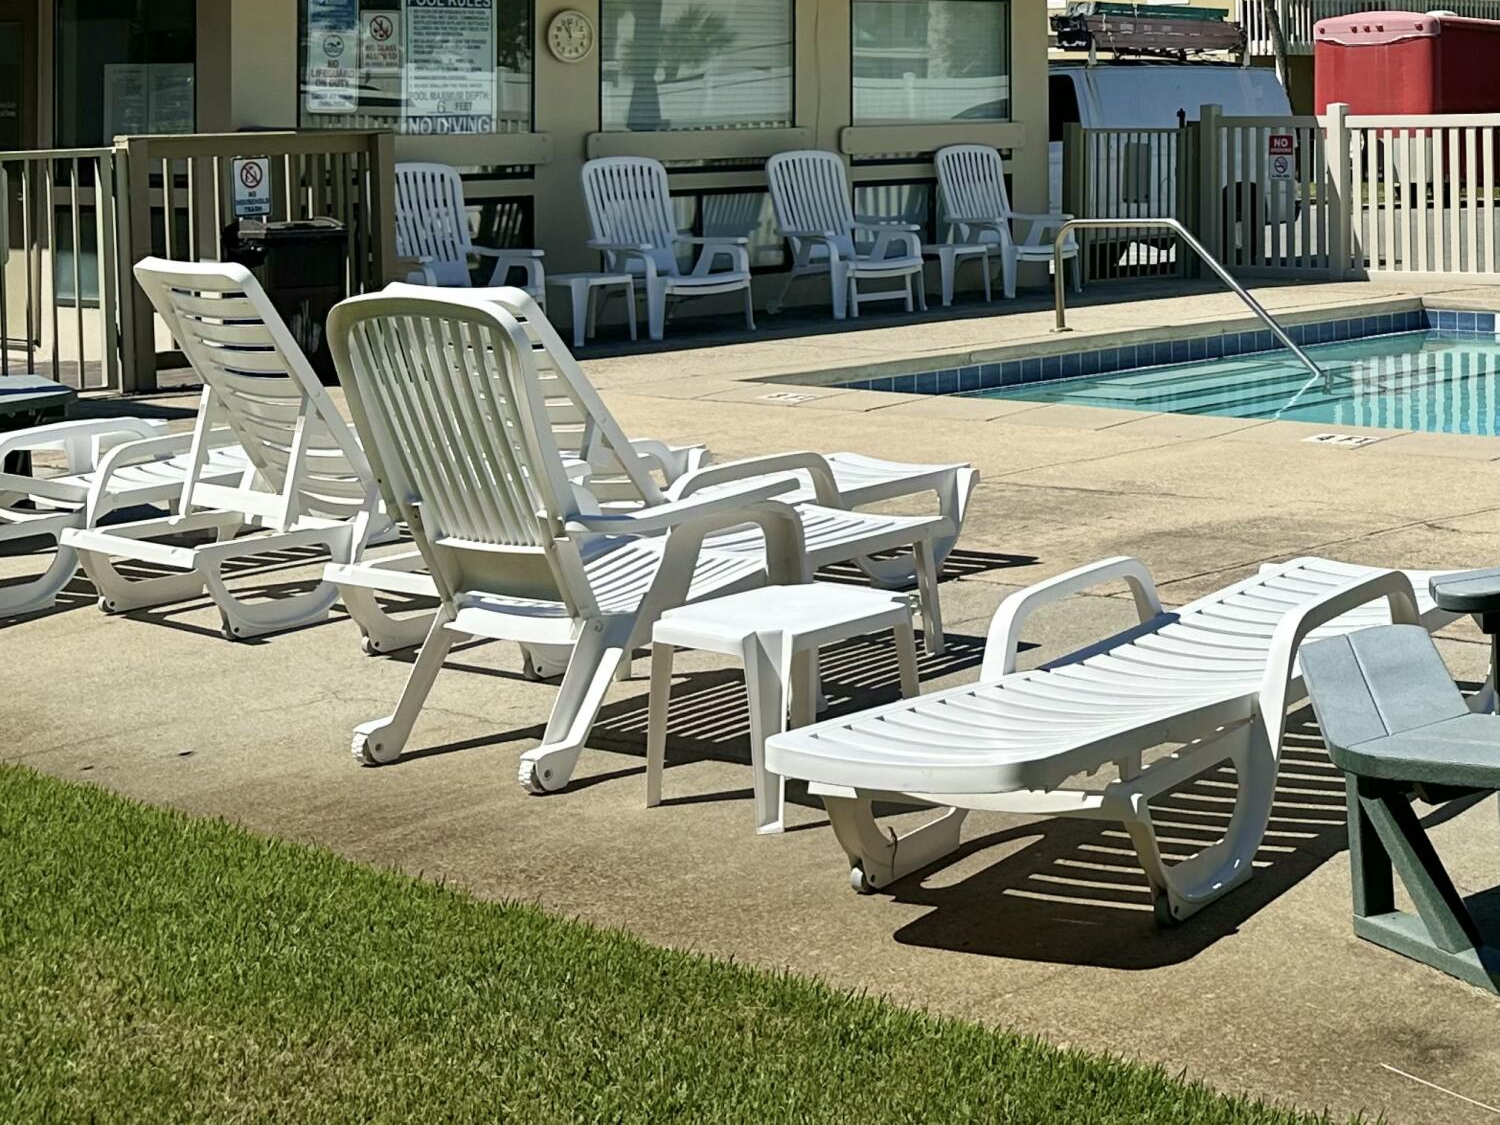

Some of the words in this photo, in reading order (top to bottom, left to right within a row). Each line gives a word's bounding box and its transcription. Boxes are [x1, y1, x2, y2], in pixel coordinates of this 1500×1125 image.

[437, 101, 446, 113] 6
[455, 102, 472, 111] FEET
[409, 117, 432, 134] NO
[437, 117, 490, 133] DIVING
[1273, 138, 1289, 147] NO
